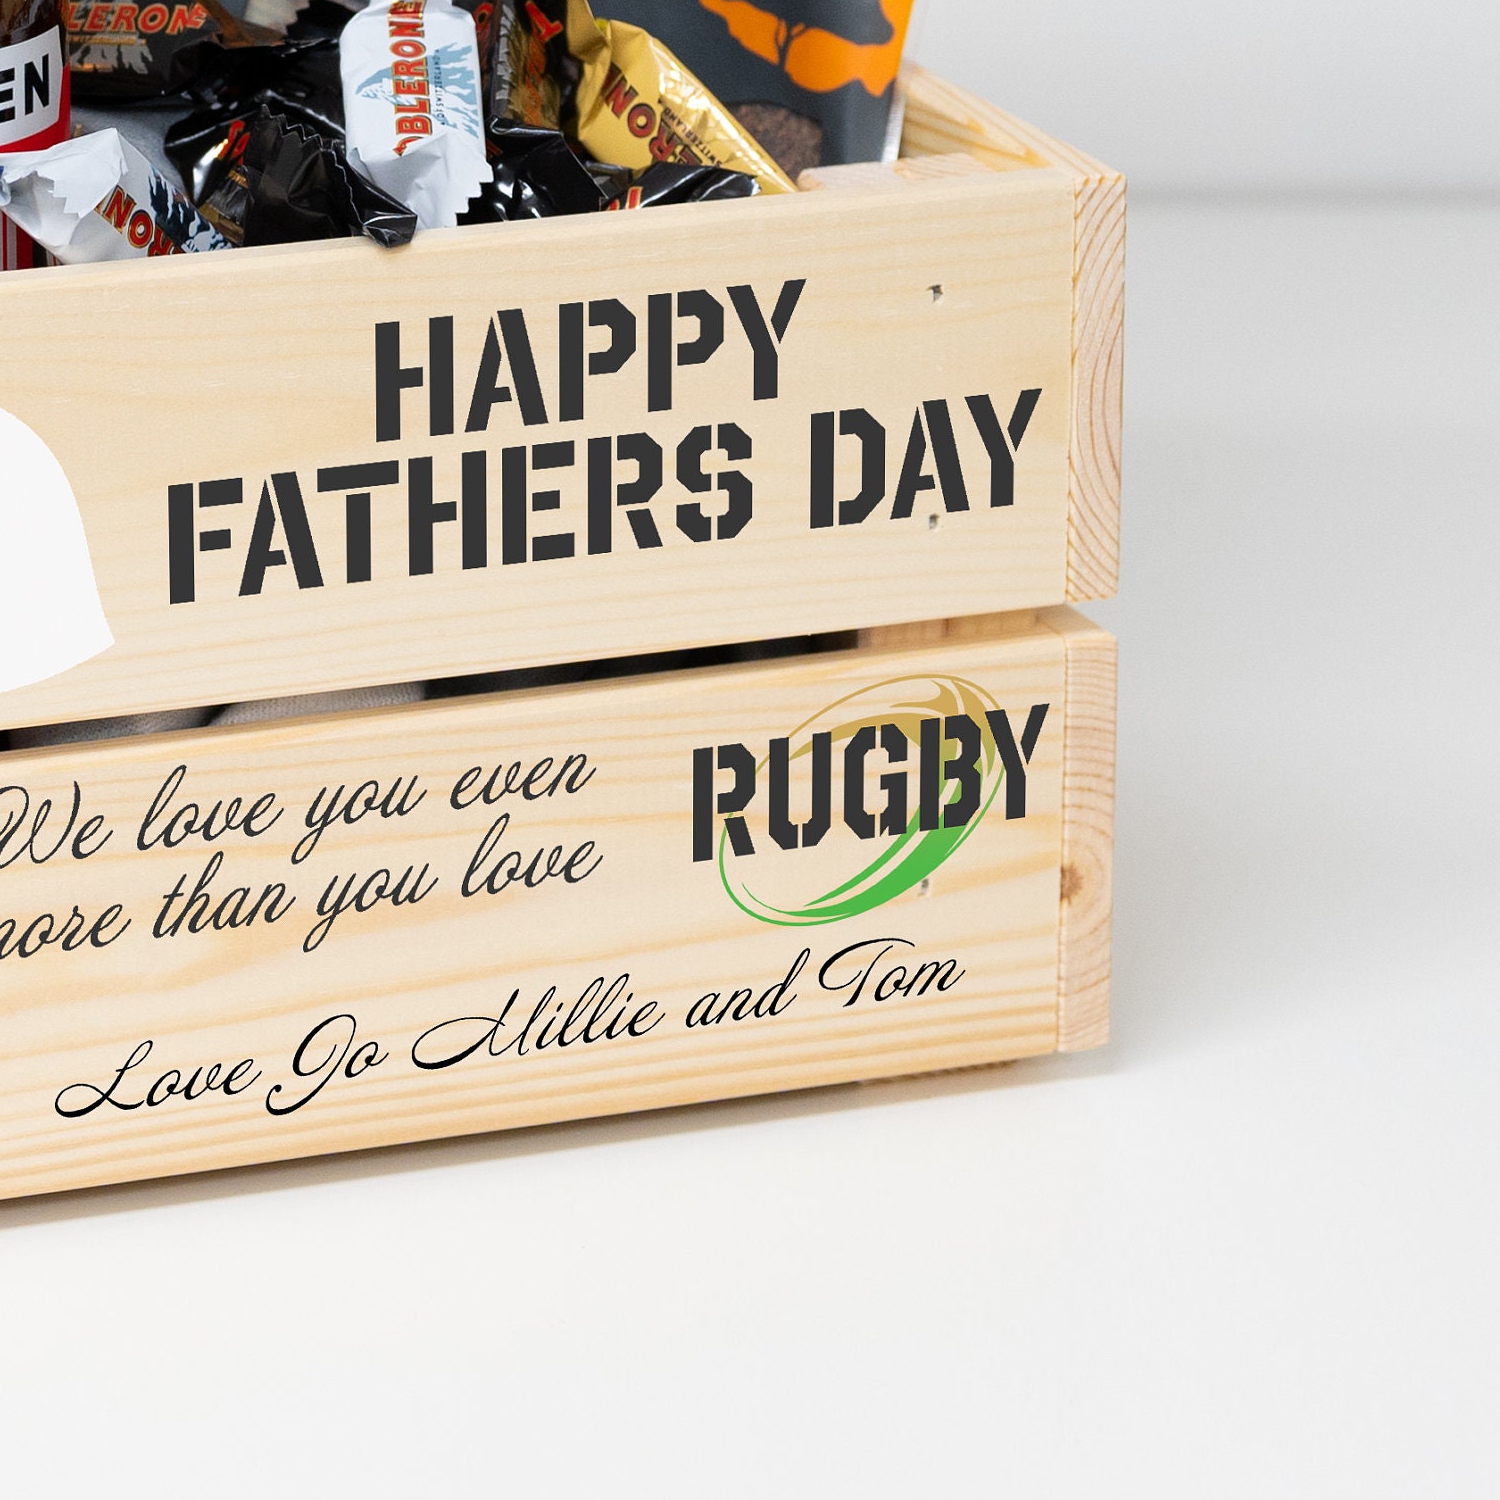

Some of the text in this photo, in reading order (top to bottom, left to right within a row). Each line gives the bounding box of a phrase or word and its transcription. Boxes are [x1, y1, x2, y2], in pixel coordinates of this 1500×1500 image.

[375, 279, 806, 442] HAPPY
[168, 388, 1042, 605] FATHERS DAY
[136, 764, 284, 851] love
[291, 775, 428, 866] you
[450, 753, 597, 810] even
[692, 703, 1050, 862] RUGBY
[152, 851, 296, 939] than
[302, 863, 439, 953] you
[461, 812, 604, 898] love
[54, 1040, 262, 1118] Love
[411, 973, 666, 1071] Millie
[685, 947, 811, 1029] and
[818, 937, 966, 1008] Tom
